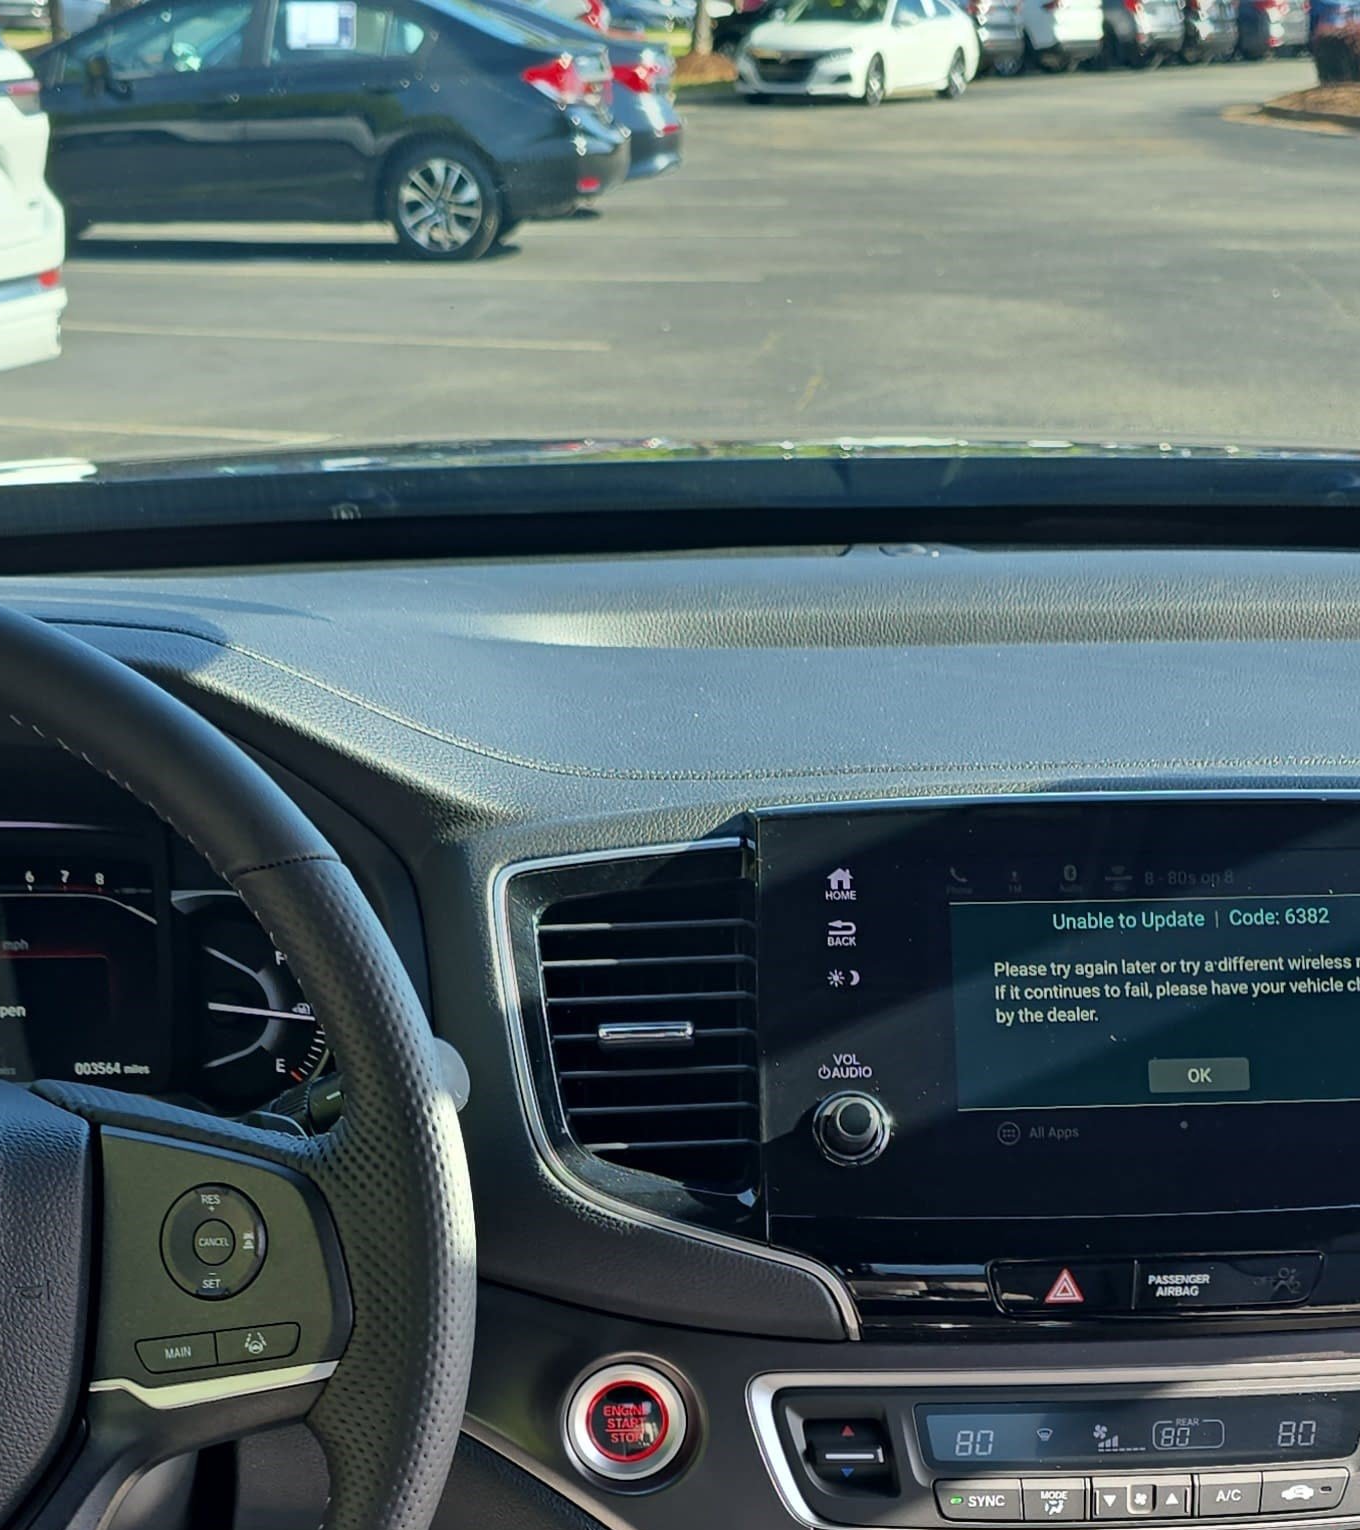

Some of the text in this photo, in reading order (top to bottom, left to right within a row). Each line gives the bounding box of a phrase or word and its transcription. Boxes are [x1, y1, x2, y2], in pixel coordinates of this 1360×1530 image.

[25, 871, 35, 883] 6
[60, 870, 70, 883] 7
[95, 873, 105, 885] 8
[825, 890, 857, 900] HOME
[1052, 907, 1331, 931] Unable to Update Code: 6382
[827, 936, 857, 947] BACK
[993, 961, 1047, 978] Please
[1050, 963, 1071, 979] try
[1074, 960, 1118, 978] again
[1121, 959, 1156, 975] later
[1160, 962, 1177, 974] or
[1179, 959, 1201, 976] try
[1204, 960, 1215, 973] a
[1218, 956, 1285, 972] different
[1288, 954, 1353, 971] wireless
[994, 985, 1007, 1000] If
[1010, 984, 1021, 1000] it
[1024, 984, 1101, 1000] continues
[1104, 984, 1121, 998] to
[1124, 981, 1153, 999] fail,
[1156, 980, 1208, 1000] please
[1211, 979, 1249, 995] have
[1251, 981, 1286, 998] your
[1289, 977, 1344, 993] vehicle
[995, 1006, 1099, 1026] by the dealer.
[276, 1058, 287, 1073] E
[833, 1053, 860, 1066] VOL
[74, 1062, 121, 1076] 003564
[832, 1066, 873, 1079] AUDIO
[1187, 1067, 1213, 1084] OK
[1029, 1126, 1080, 1142] All Apps
[201, 1194, 221, 1205] RES
[198, 1237, 230, 1247] CANCEL
[202, 1278, 221, 1289] SET
[1148, 1274, 1211, 1286] PASSENGER
[1155, 1285, 1200, 1297] AIRBAG
[165, 1346, 192, 1360] MAIN
[1175, 1417, 1201, 1427] REAR
[1160, 1426, 1190, 1447] 80
[1277, 1420, 1317, 1448] 80
[955, 1429, 994, 1457] 80
[968, 1495, 1006, 1508] SYNC
[1040, 1490, 1068, 1500] MODE
[1216, 1489, 1242, 1503] A/C
